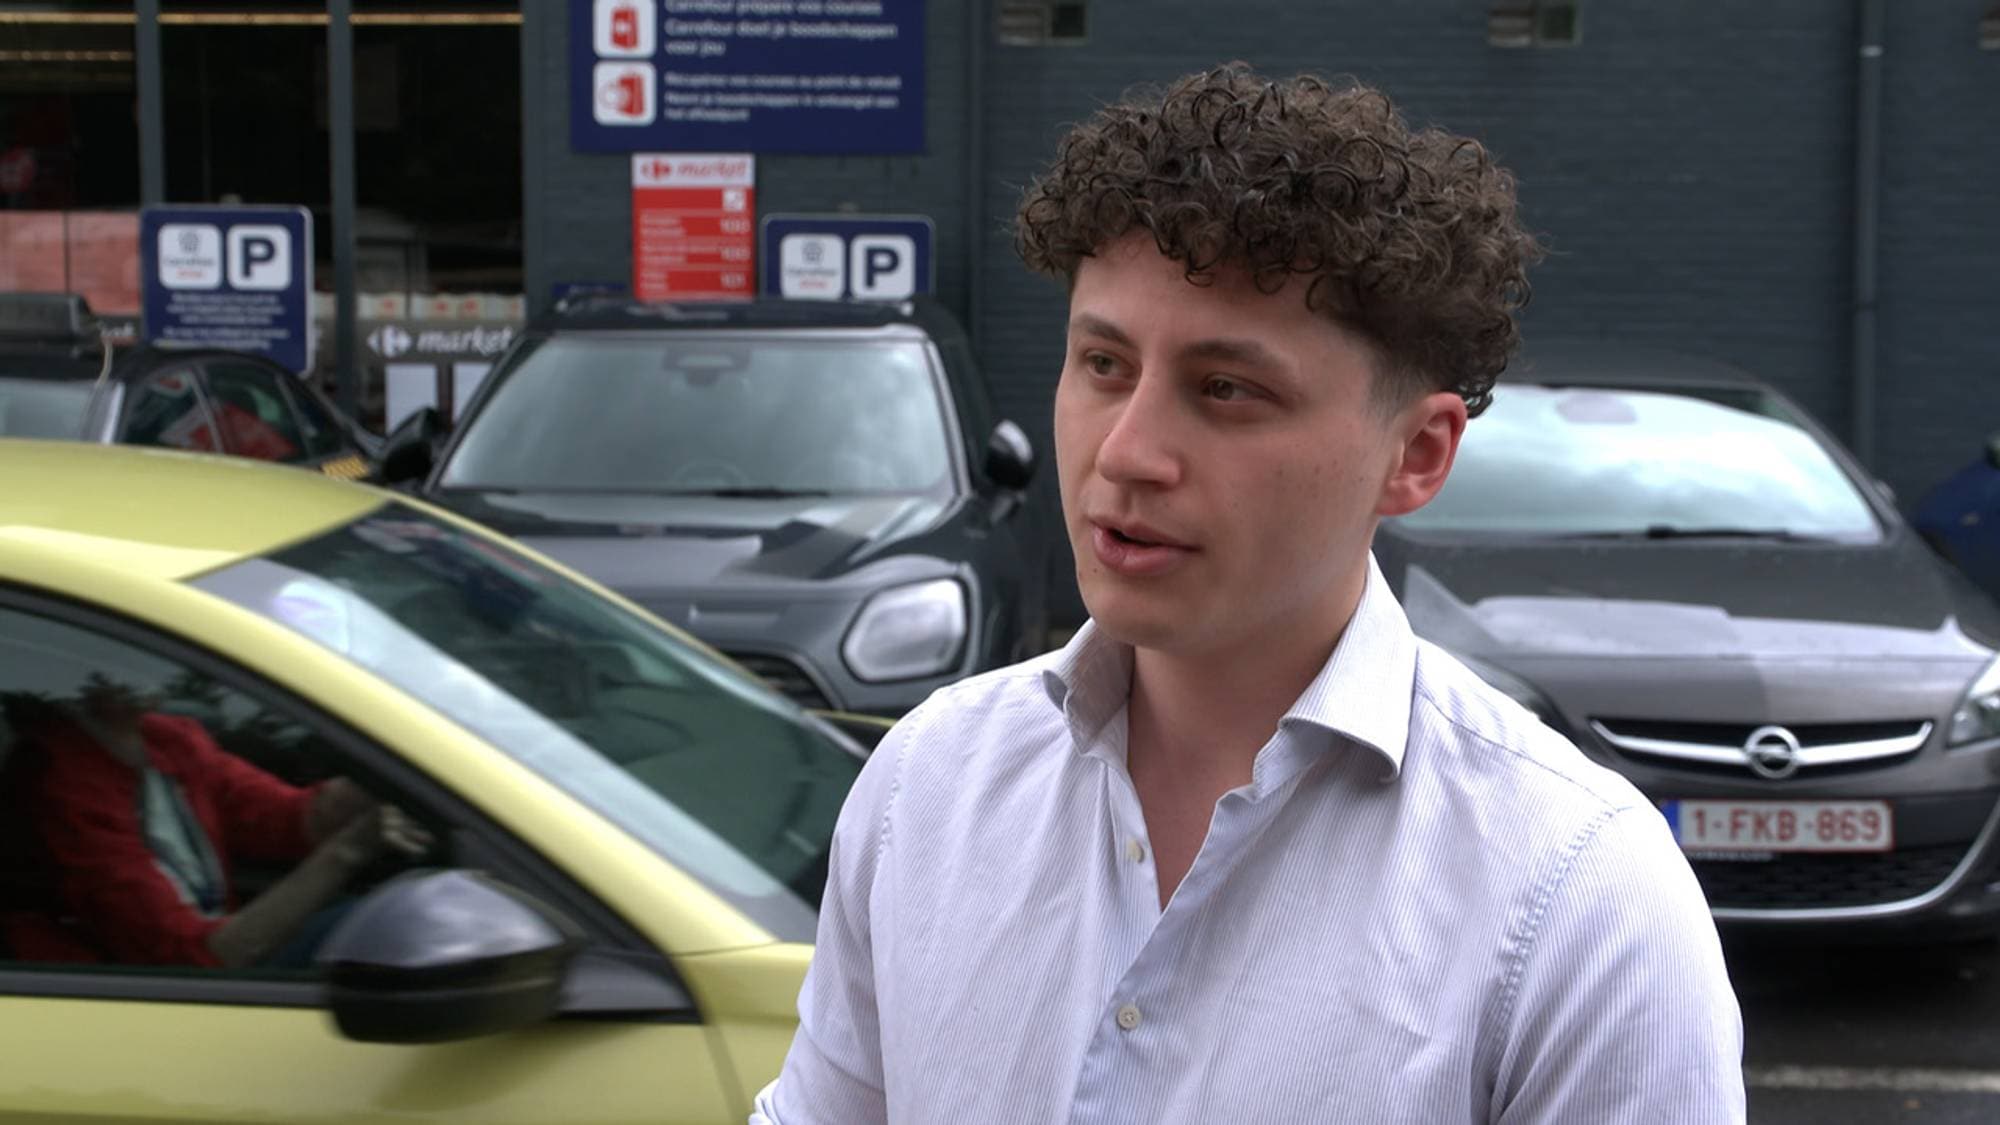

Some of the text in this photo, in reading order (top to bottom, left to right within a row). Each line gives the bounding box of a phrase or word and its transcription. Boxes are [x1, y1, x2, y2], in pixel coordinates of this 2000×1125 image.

[664, 0, 734, 14] Carrefour
[664, 18, 898, 41] Carrefour doet je boodschappen
[664, 42, 697, 55] voor
[677, 161, 747, 178] market
[241, 237, 275, 277] P
[865, 246, 900, 289] P
[416, 326, 513, 357] market
[1692, 808, 1882, 843] 1-FKB-869
